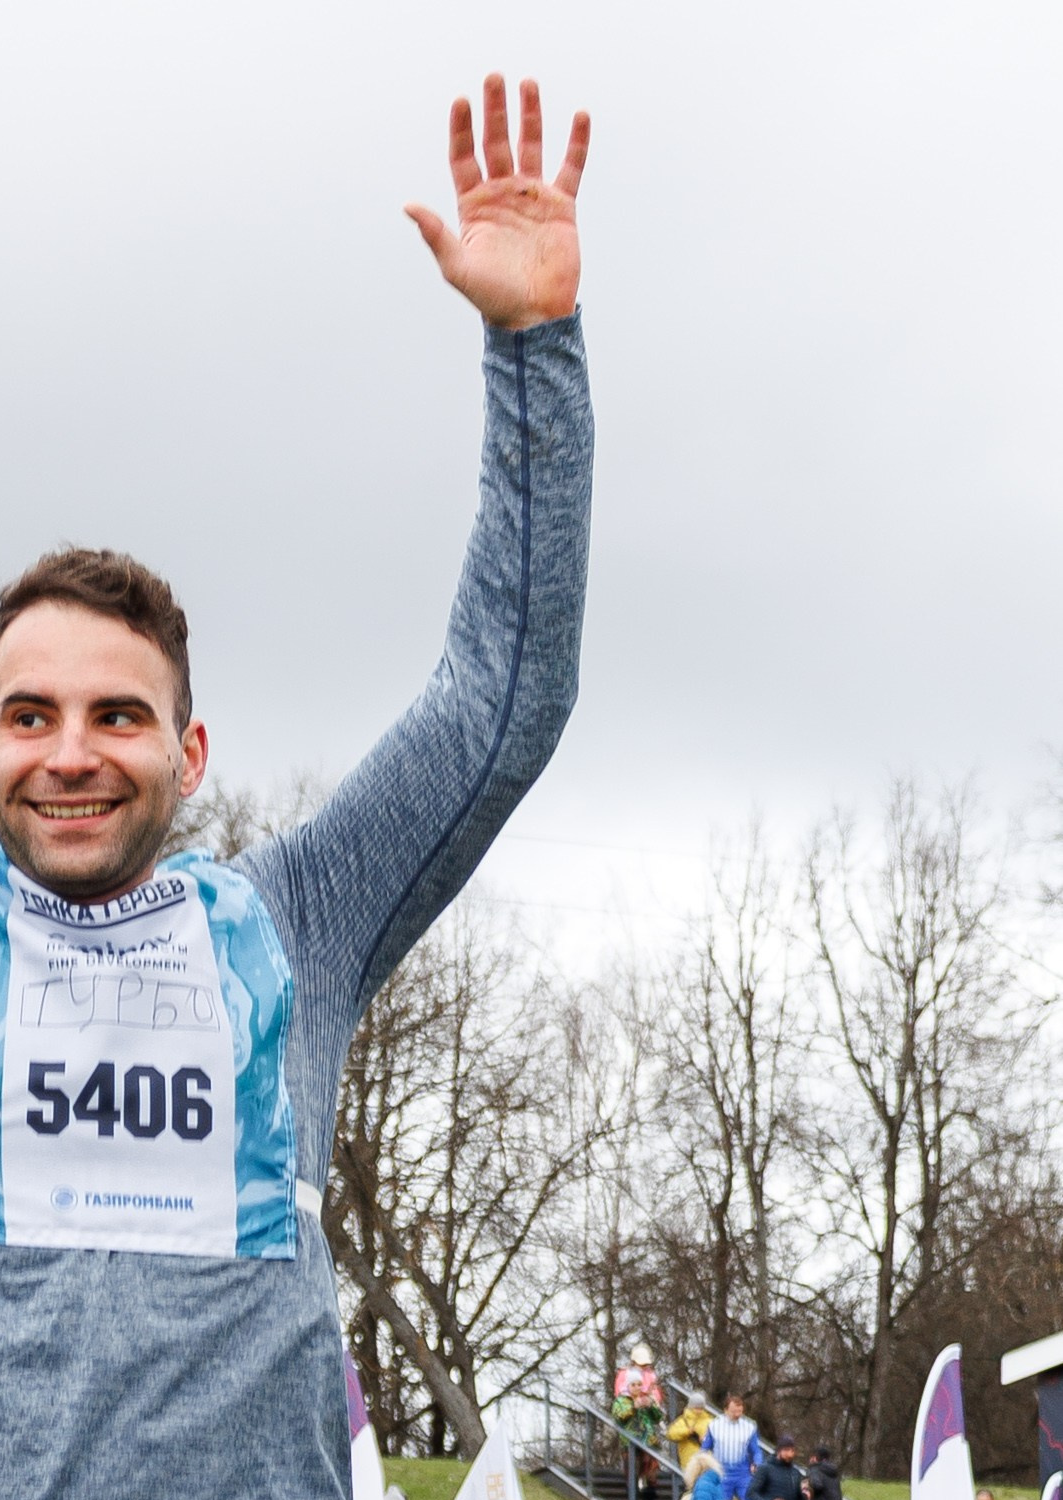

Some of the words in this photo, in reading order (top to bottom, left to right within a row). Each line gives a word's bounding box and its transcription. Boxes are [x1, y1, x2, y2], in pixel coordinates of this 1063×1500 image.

[105, 878, 186, 919] ГЕРОЕВ
[48, 956, 78, 972] FINE
[86, 953, 188, 974] DEVELOPMENT
[26, 1059, 213, 1141] 5406
[84, 1191, 194, 1211] ГАЗПРОМБАНК
